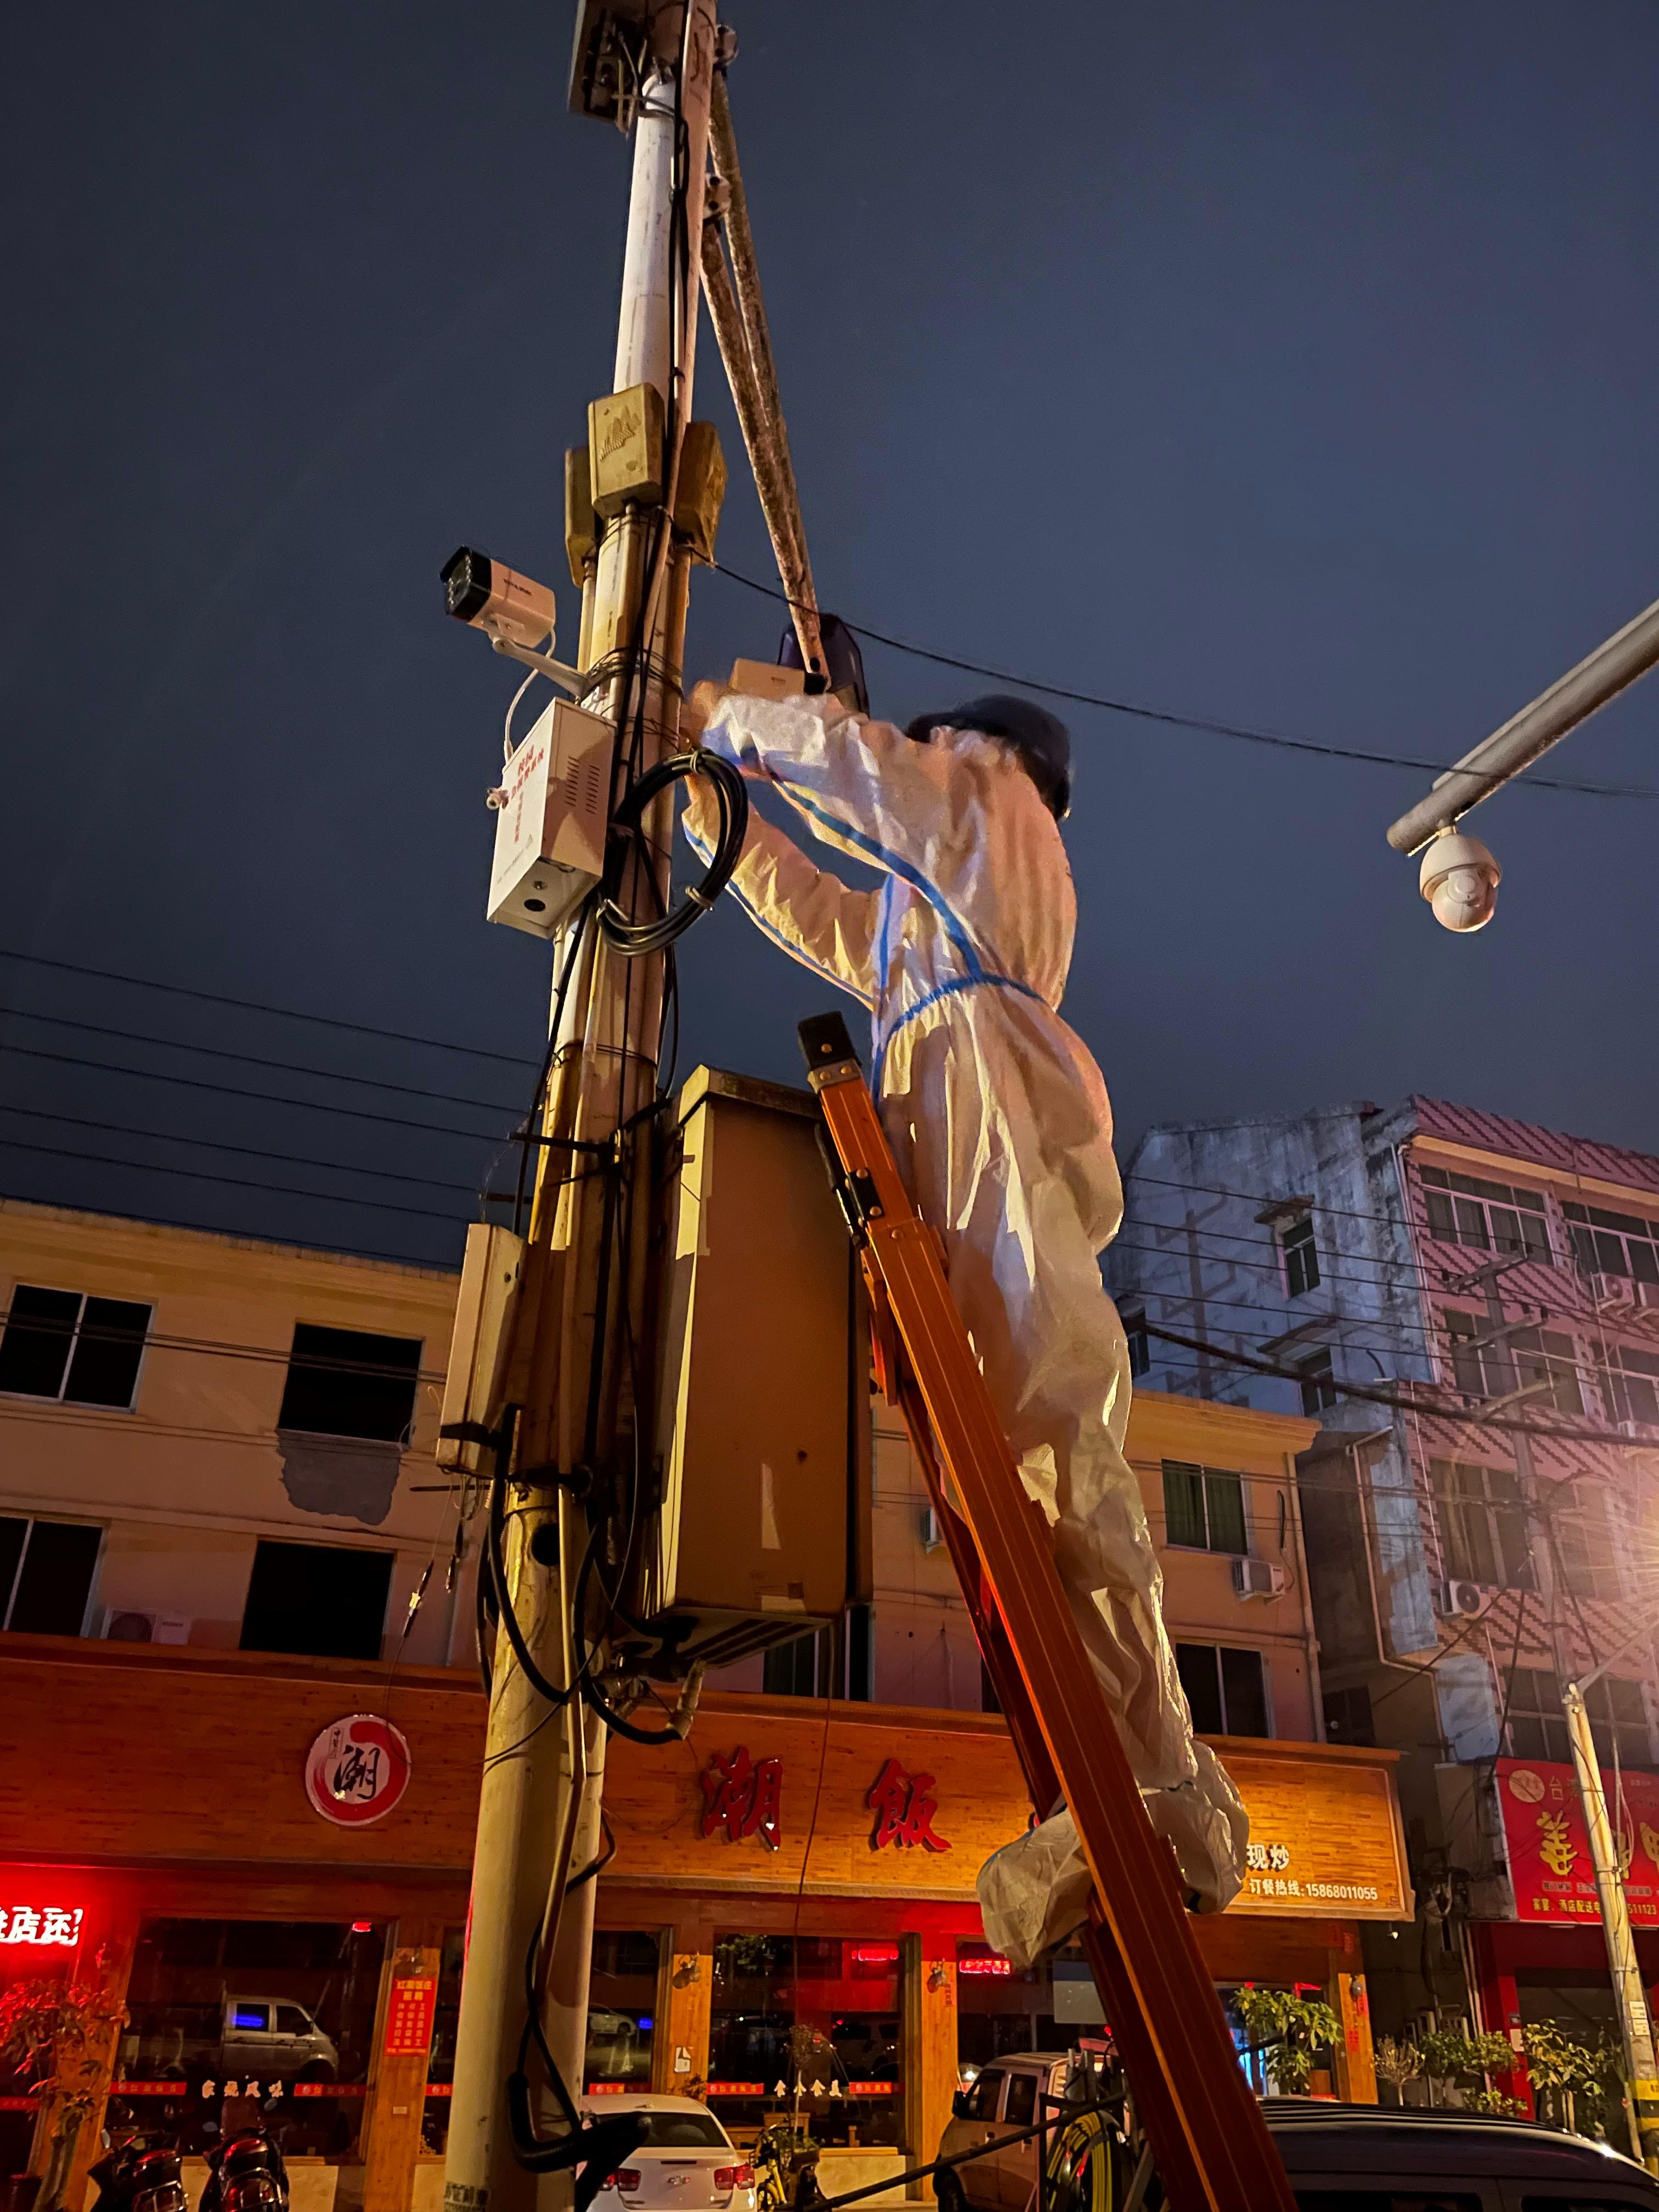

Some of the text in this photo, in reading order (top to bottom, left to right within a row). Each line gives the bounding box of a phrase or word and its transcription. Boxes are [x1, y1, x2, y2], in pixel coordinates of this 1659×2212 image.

[1247, 1844, 1290, 1870] 现炒
[1249, 1878, 1378, 1900] 订餐热线:15868011055
